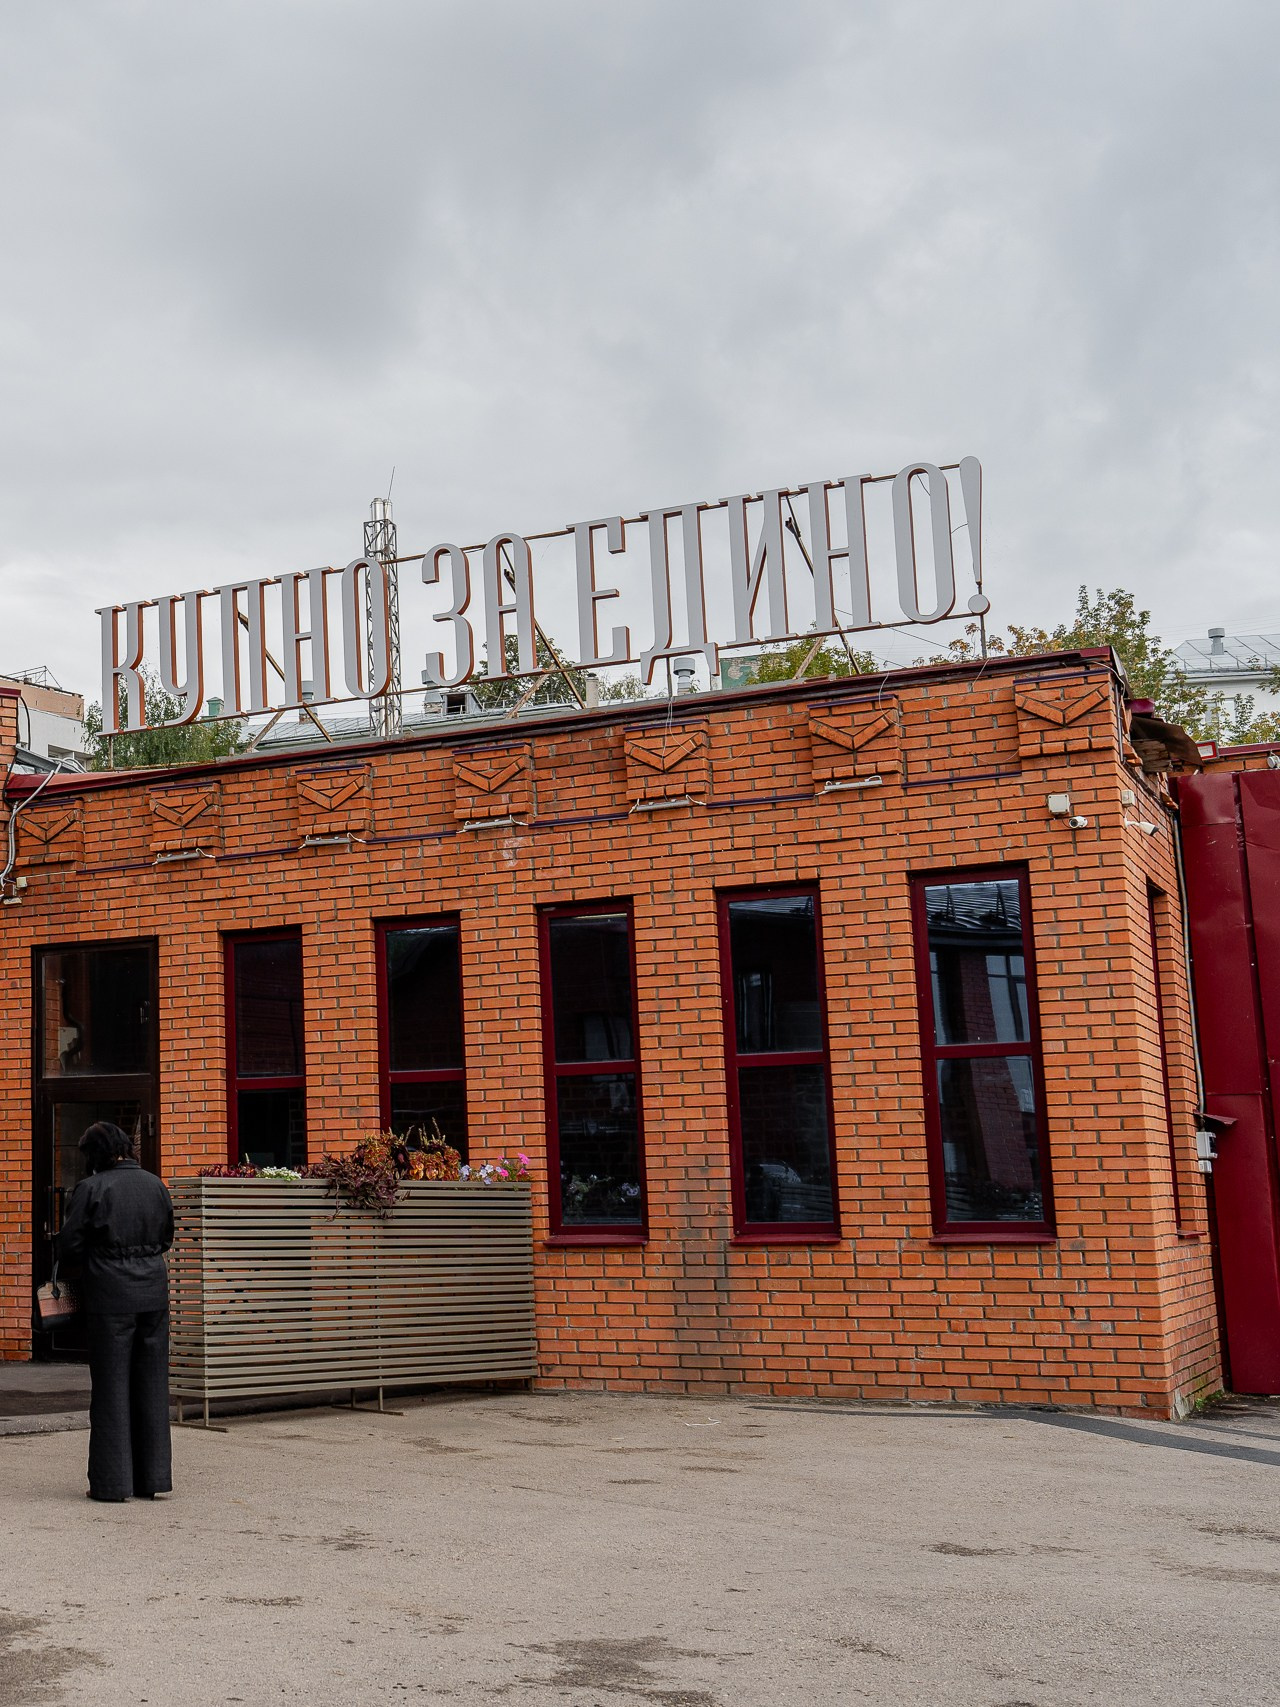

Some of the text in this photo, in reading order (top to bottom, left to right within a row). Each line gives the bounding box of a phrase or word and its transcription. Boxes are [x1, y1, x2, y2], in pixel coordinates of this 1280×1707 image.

[95, 455, 991, 737] КУПНО ЗА ЕДИНО!
